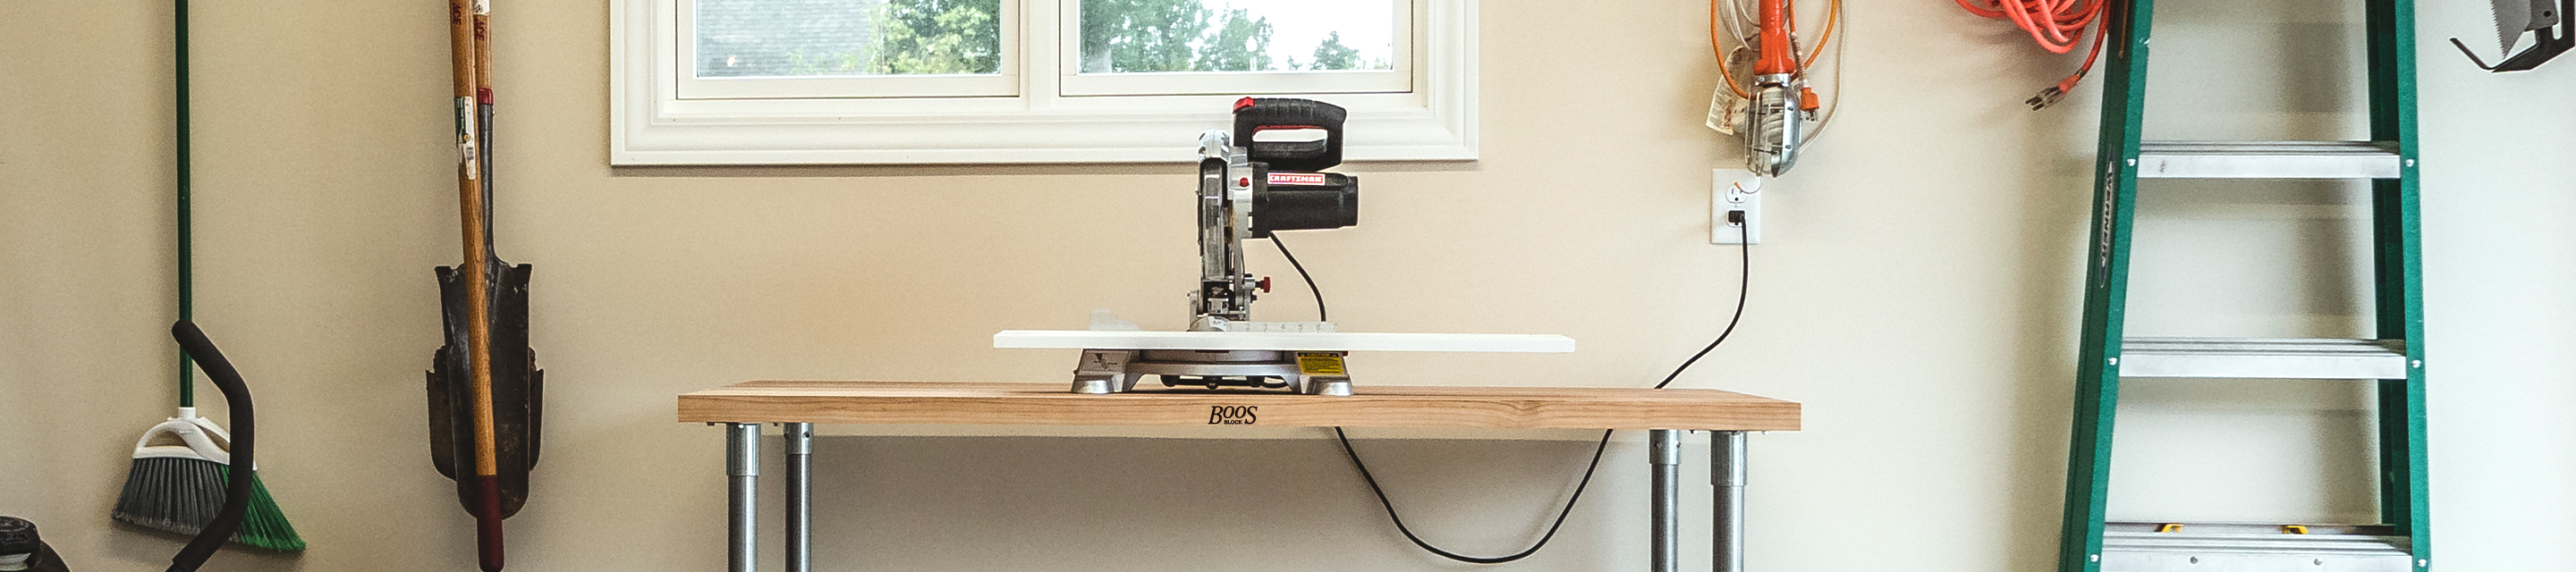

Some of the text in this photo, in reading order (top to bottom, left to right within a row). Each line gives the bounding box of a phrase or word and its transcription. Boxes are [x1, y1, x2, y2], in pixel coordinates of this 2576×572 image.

[452, 2, 462, 25] ACE
[474, 17, 485, 41] ACE
[2102, 172, 2113, 258] WERNER
[1208, 405, 1258, 425] BOOS
